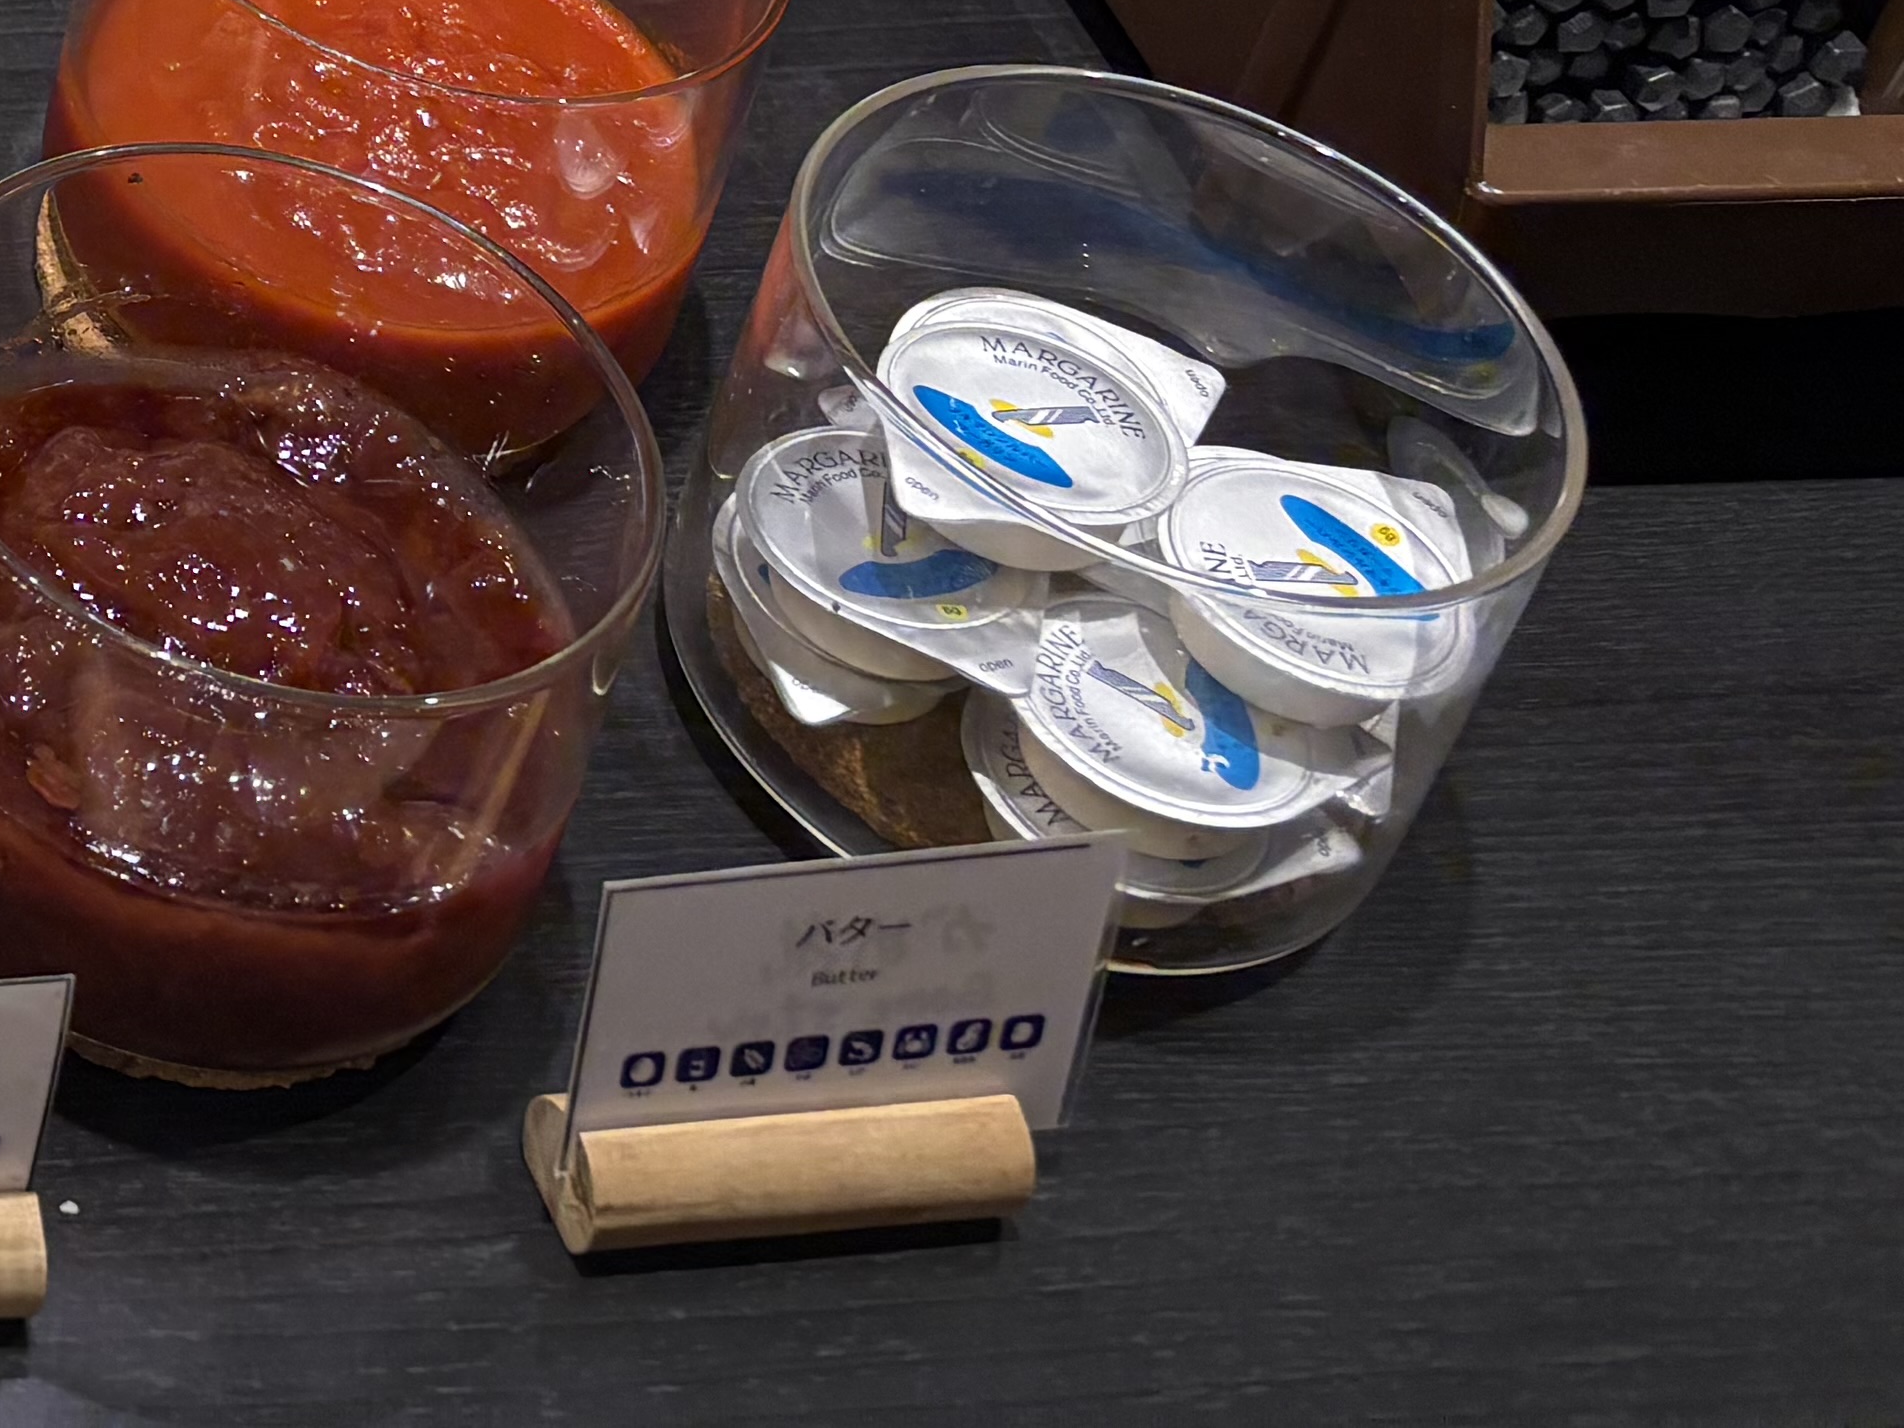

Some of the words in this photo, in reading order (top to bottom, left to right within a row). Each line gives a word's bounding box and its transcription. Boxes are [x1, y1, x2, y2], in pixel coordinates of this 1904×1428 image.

[980, 335, 1147, 441] MARGARINE
[993, 353, 1038, 371] Marin
[1041, 364, 1079, 391] Food
[770, 449, 888, 504] MARGARI
[822, 469, 858, 486] Food
[905, 475, 940, 501] open
[978, 657, 1014, 674] open
[1037, 625, 1120, 764] MARGARINE
[1000, 729, 1073, 827] MARGA
[795, 915, 913, 947] バター
